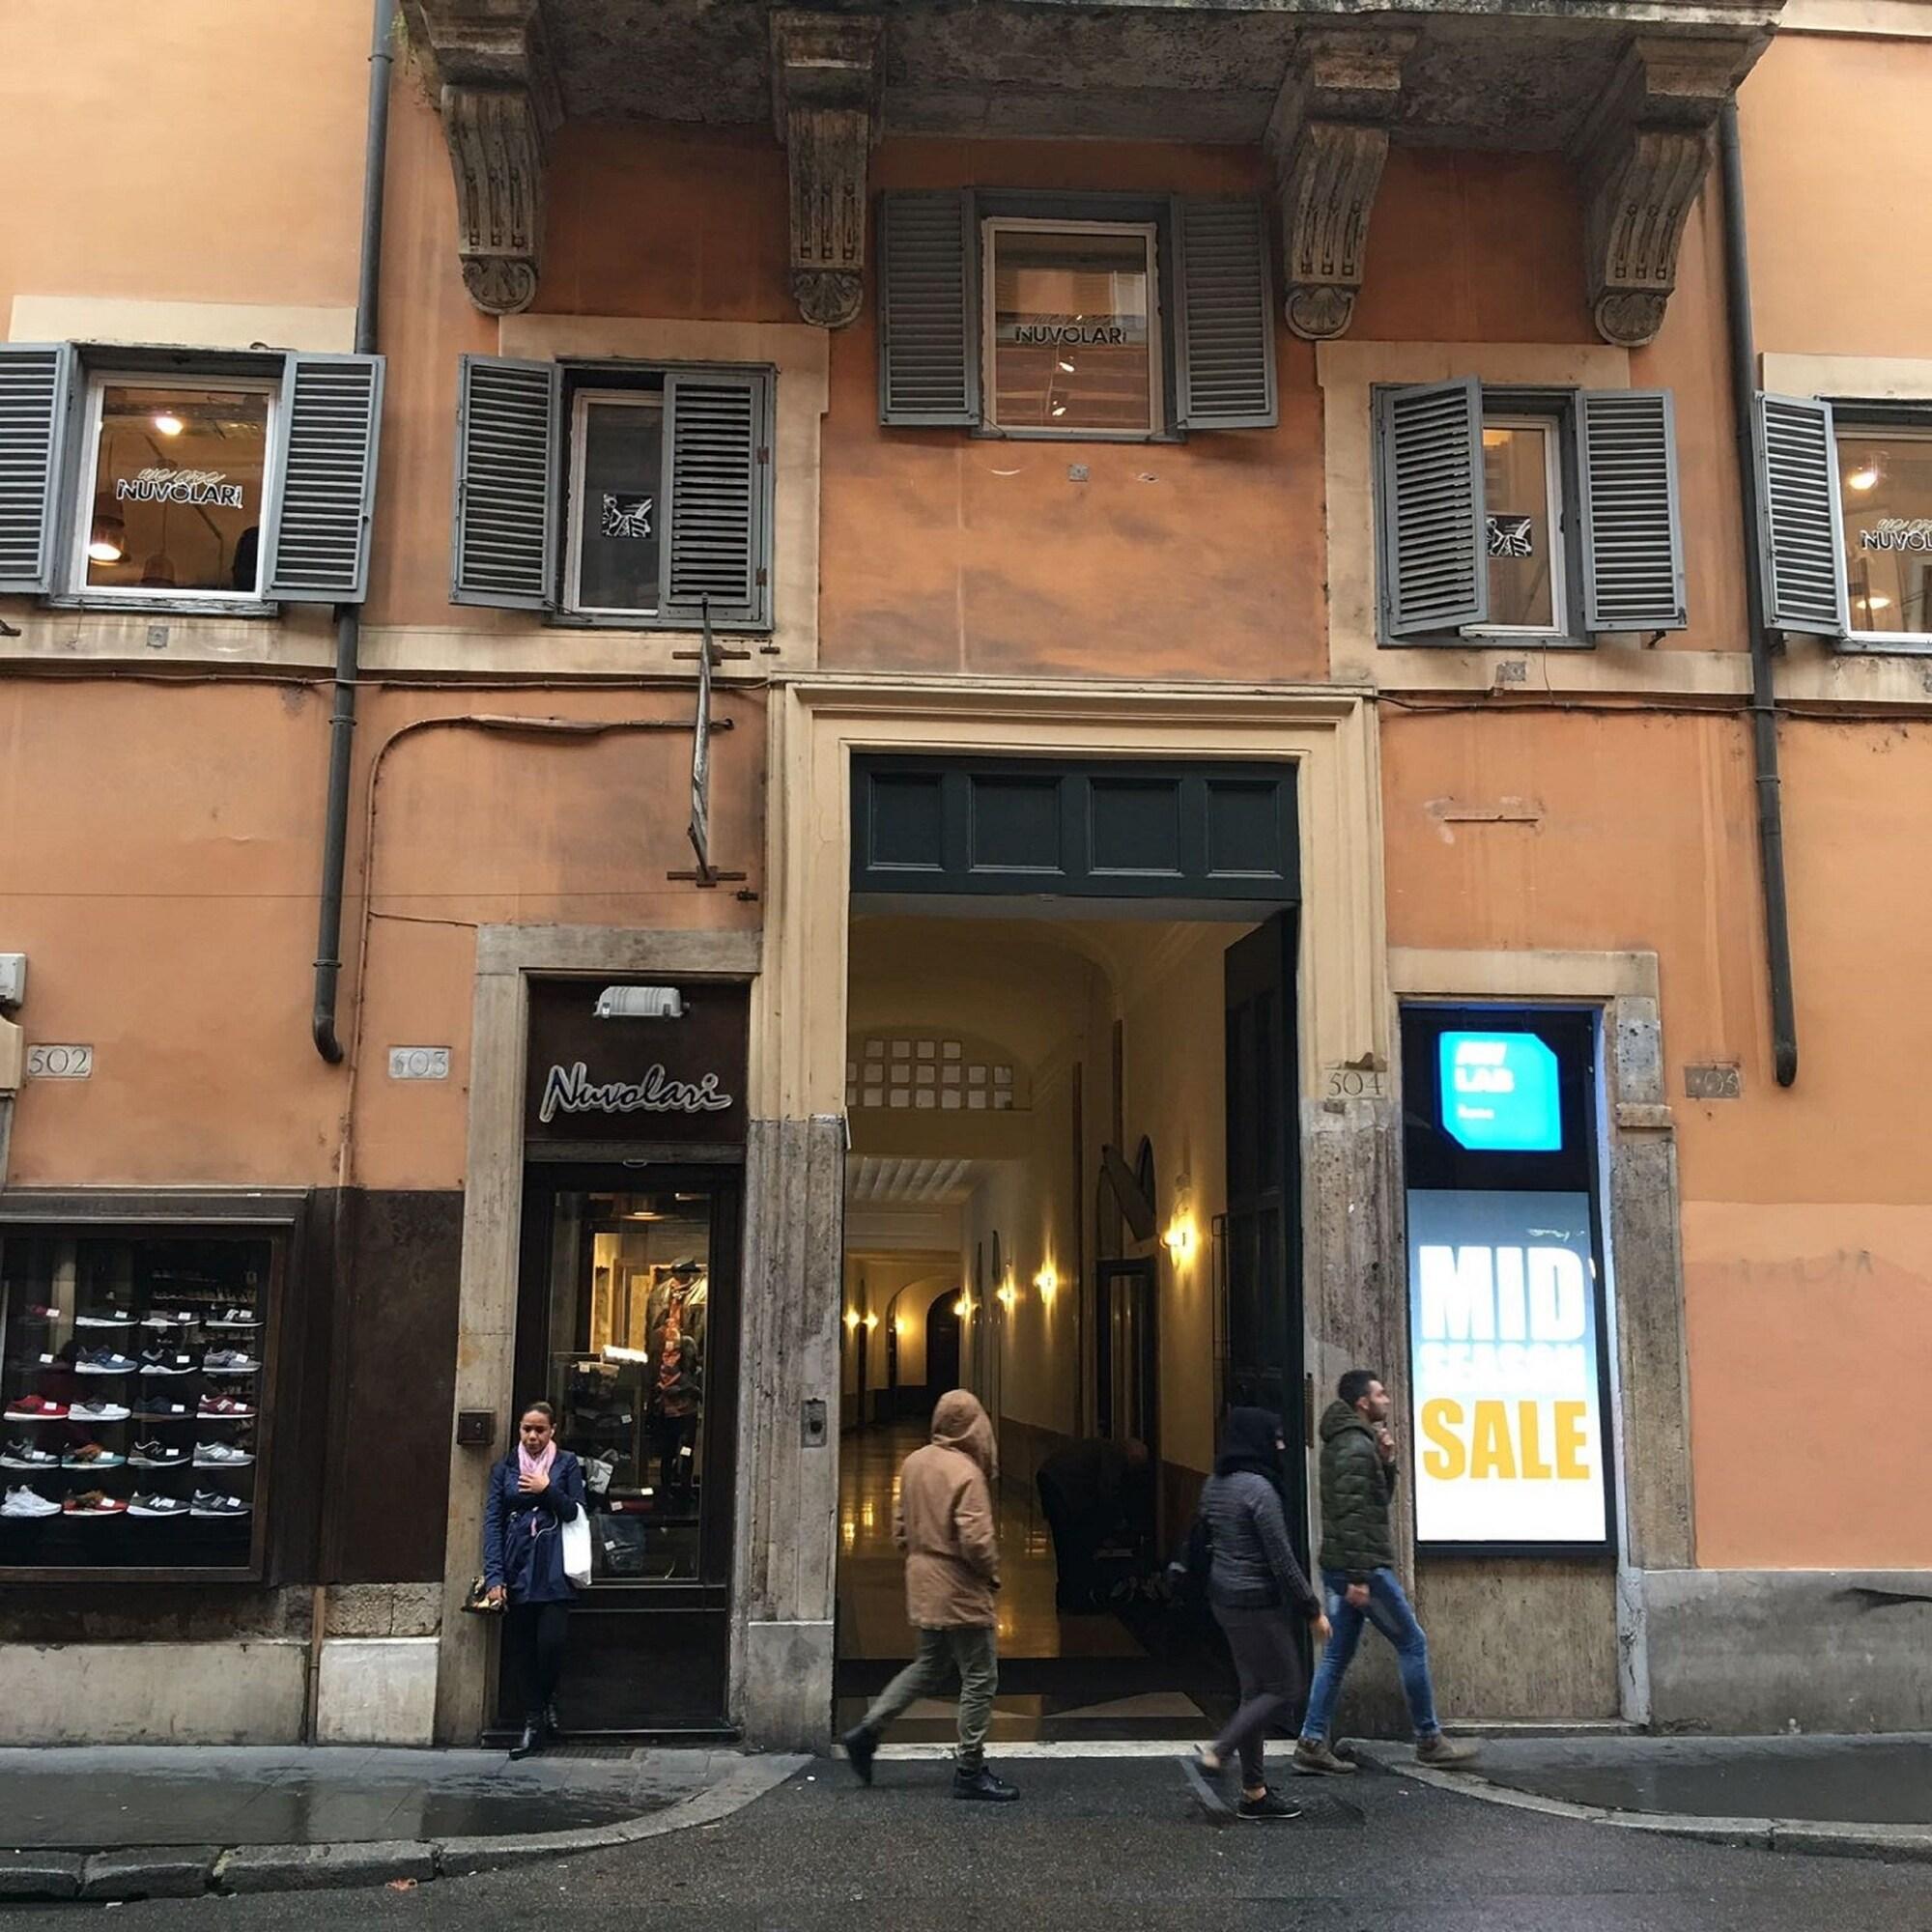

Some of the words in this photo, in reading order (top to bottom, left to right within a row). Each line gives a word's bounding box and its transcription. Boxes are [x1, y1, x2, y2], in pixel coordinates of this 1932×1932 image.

[116, 478, 243, 508] NUVOLARI
[29, 1048, 89, 1074] 502
[393, 1049, 446, 1076] 503
[539, 1062, 733, 1122] Nuvolari
[1328, 1070, 1383, 1096] 504
[1419, 1245, 1587, 1342] MID
[1421, 1398, 1591, 1481] SALE
